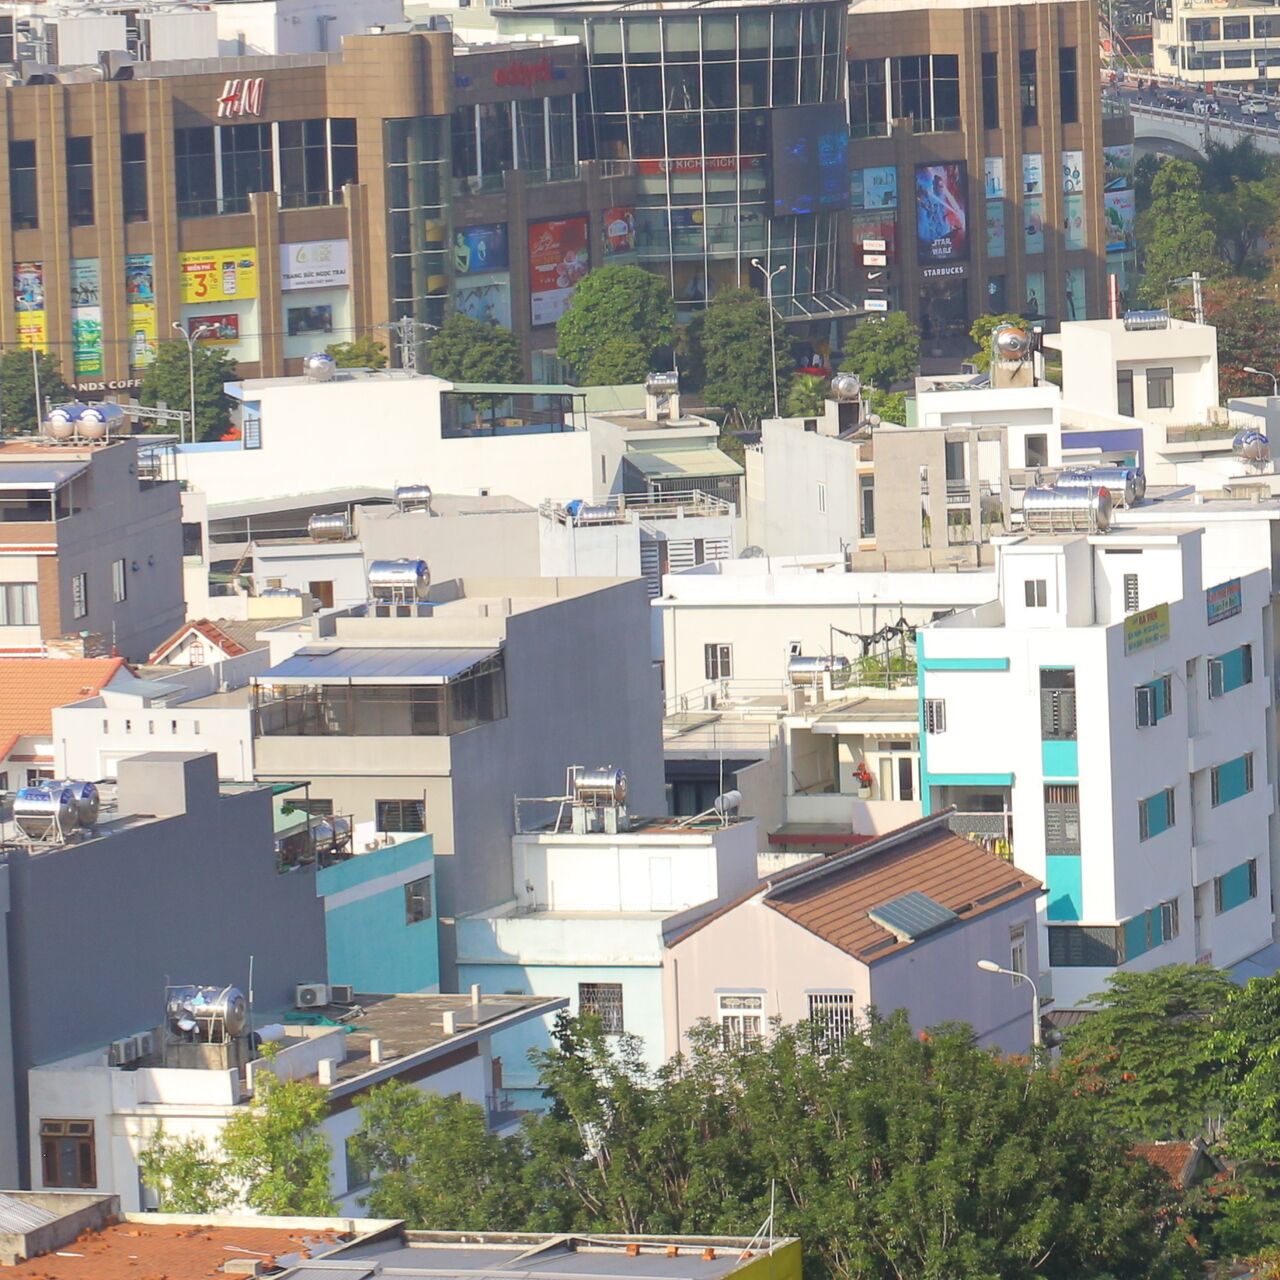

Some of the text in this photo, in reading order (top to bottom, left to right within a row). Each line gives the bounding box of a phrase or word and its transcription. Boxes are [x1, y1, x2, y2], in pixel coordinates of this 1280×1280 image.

[216, 77, 265, 118] H&M
[931, 238, 952, 247] STAR
[931, 246, 953, 255] WARS
[923, 266, 964, 277] STARBUCKS
[108, 378, 144, 389] COFF
